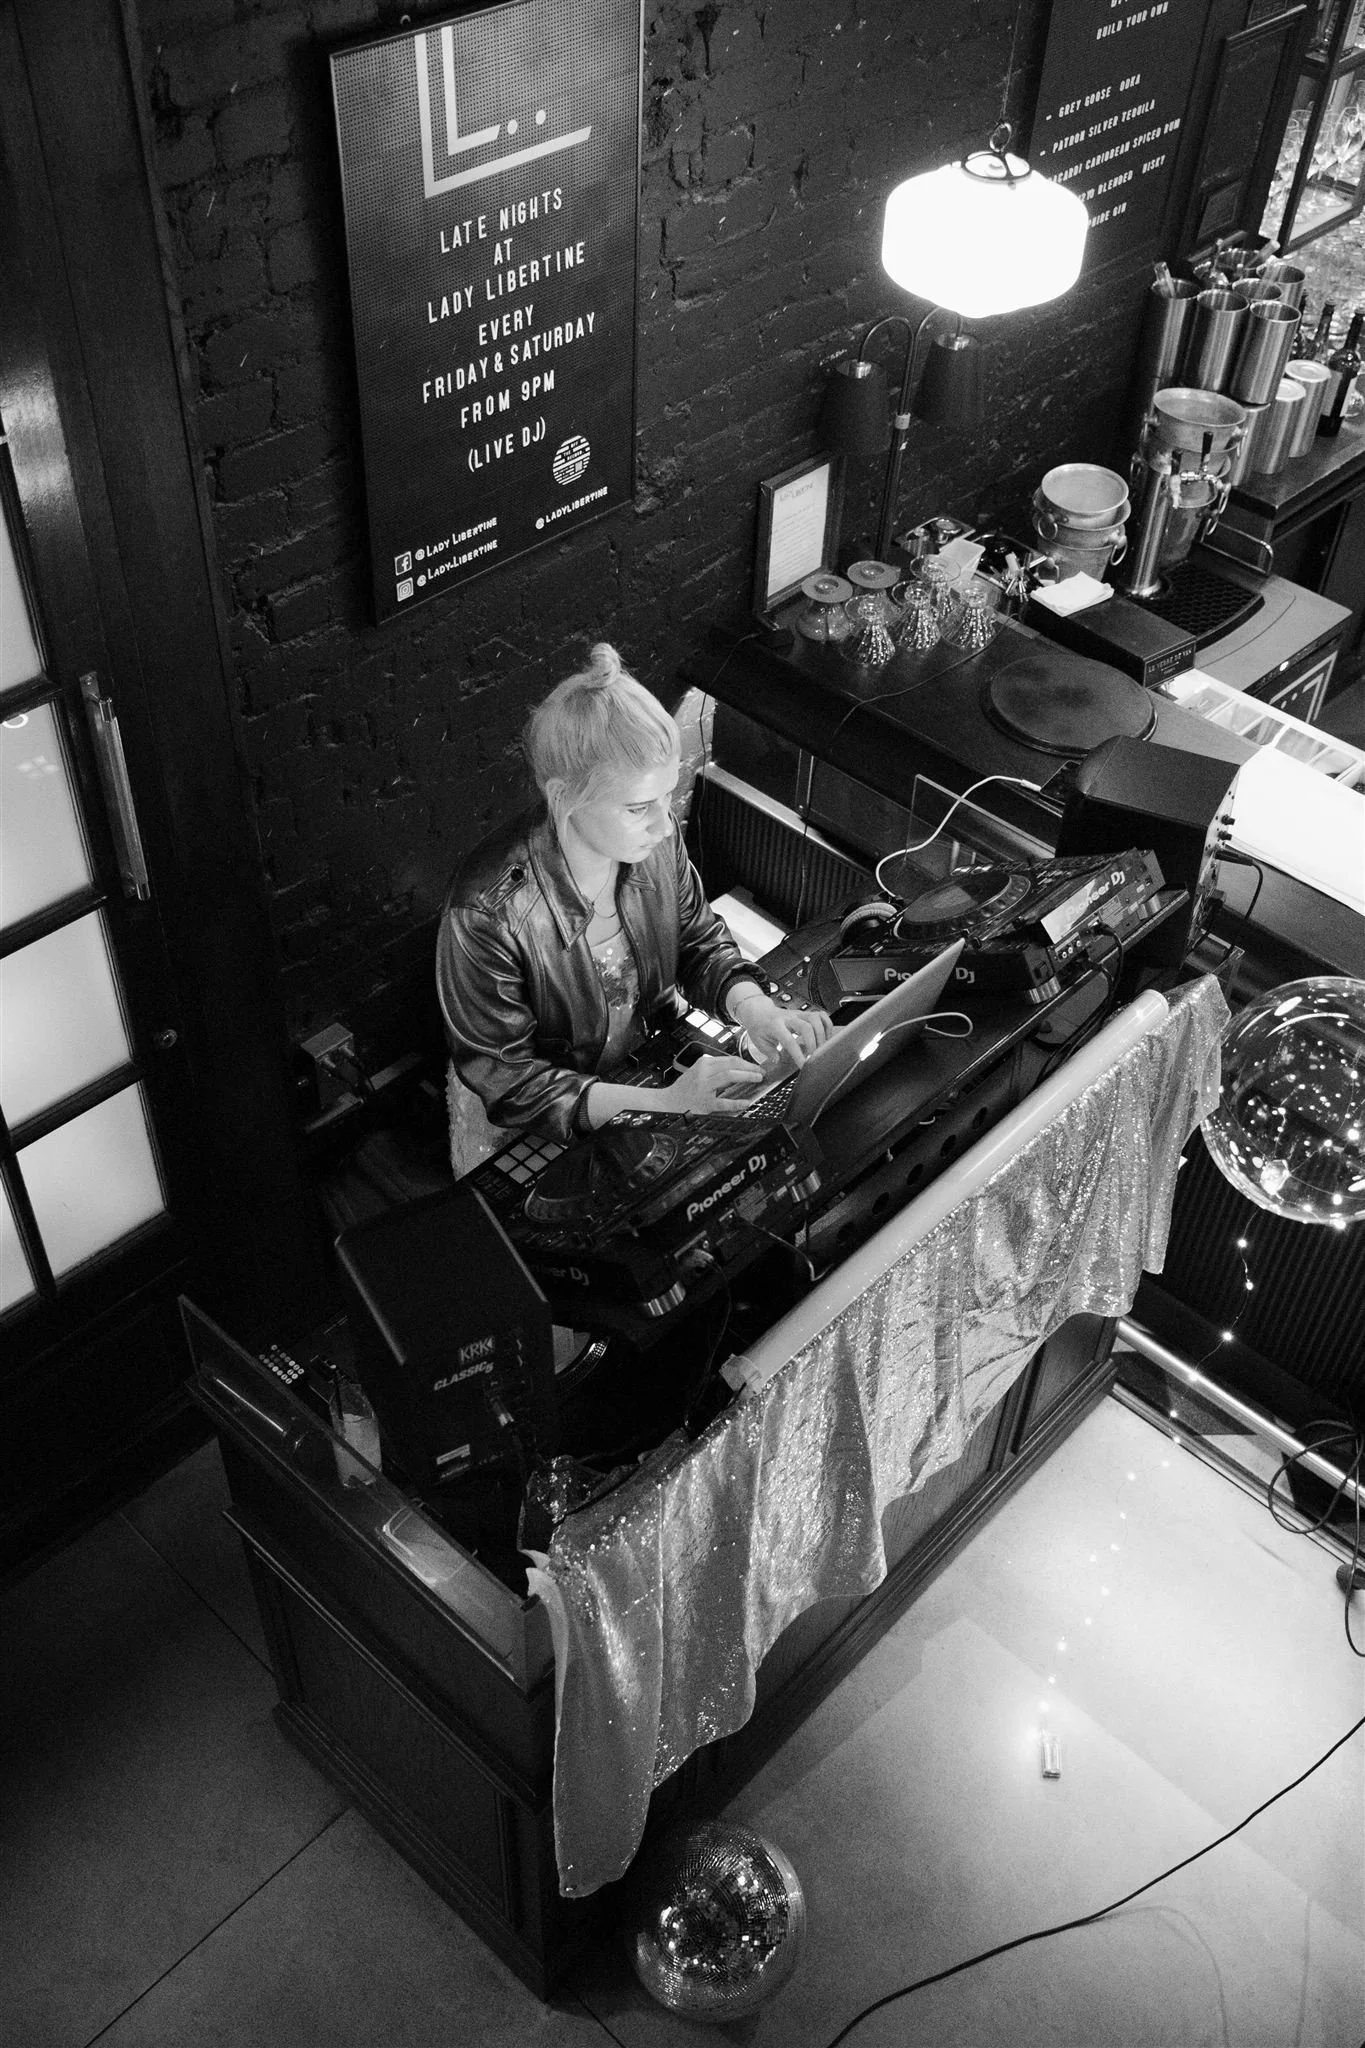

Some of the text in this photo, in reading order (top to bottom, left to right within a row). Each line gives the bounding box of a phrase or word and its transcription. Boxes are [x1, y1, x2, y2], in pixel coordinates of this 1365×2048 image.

[1126, 10, 1148, 28] YOUR
[1052, 98, 1156, 153] PATRON SILVER TEQUILA
[1058, 99, 1082, 118] GREY
[1084, 86, 1112, 107] GOOSE
[1085, 141, 1131, 170] CARIBBEAN
[1132, 127, 1162, 149] SPICED
[1163, 118, 1181, 135] RUM
[1097, 170, 1134, 195] BLENDED
[439, 188, 563, 253] LATE NIGHTS
[1112, 202, 1127, 217] GIN
[493, 238, 514, 266] AT
[427, 241, 586, 323] LADY LIBERTINE
[478, 304, 534, 346] EVERY
[422, 312, 596, 404] FRIDAY & SATURDAY
[460, 369, 556, 429] FROM 9PM
[467, 416, 547, 472] (LIVE DJ)
[452, 517, 498, 545] LIBERTINE
[686, 1169, 747, 1222] Pioneer
[459, 1337, 493, 1363] KRK
